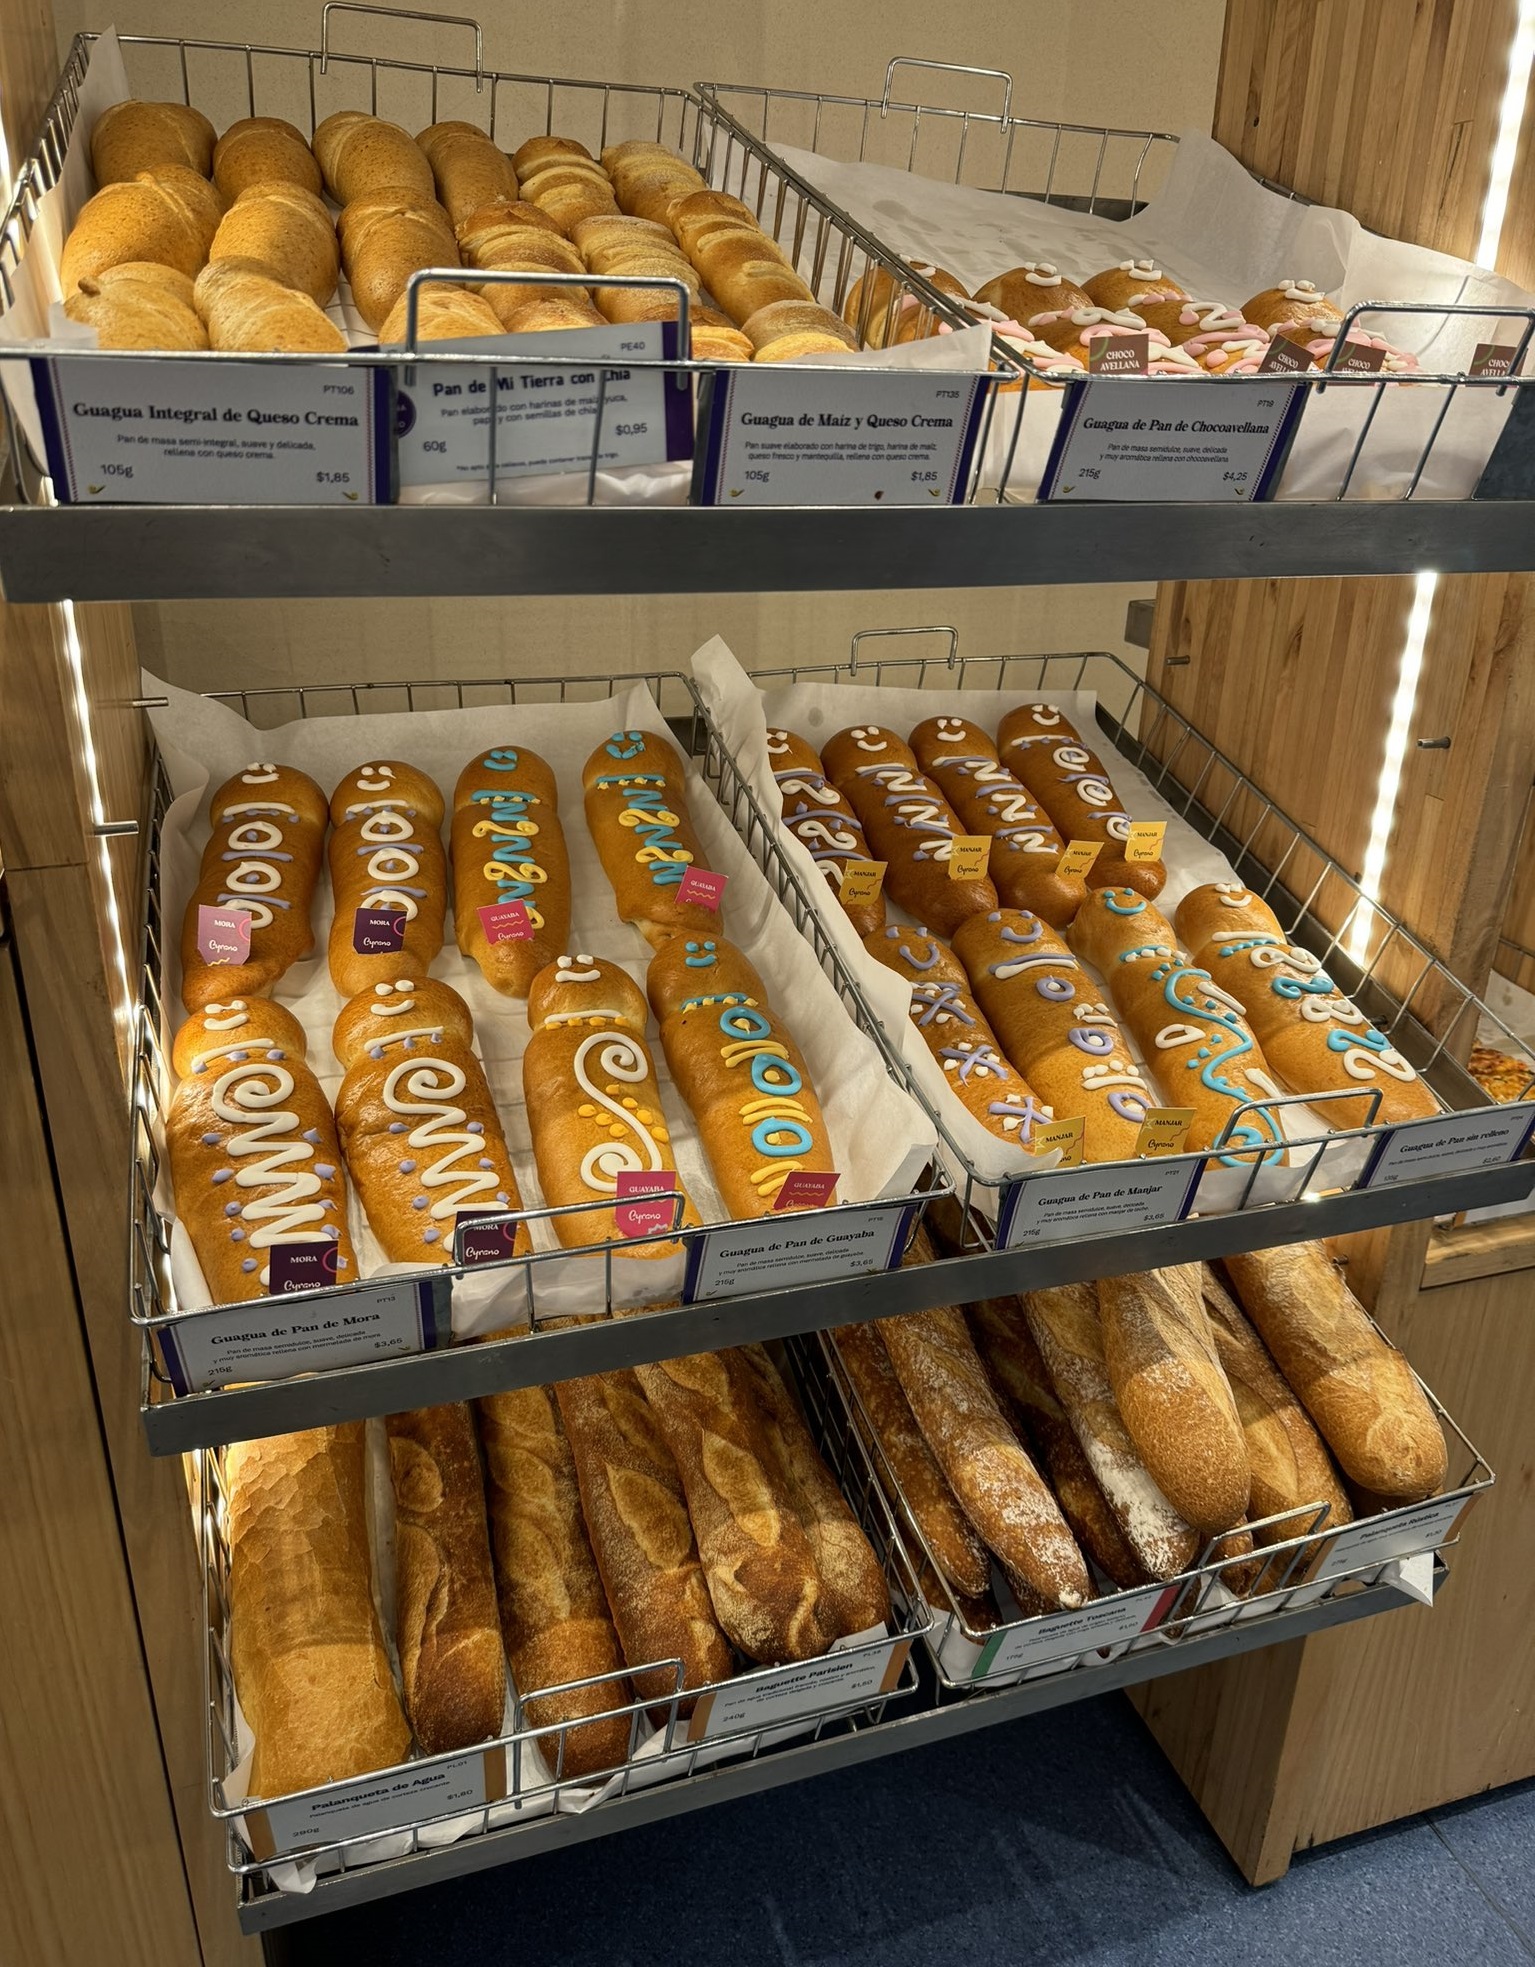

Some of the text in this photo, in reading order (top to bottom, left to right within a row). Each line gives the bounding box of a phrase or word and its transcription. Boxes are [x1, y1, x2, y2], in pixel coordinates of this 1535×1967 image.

[620, 342, 645, 351] PE40
[1106, 349, 1135, 360] CHOCO
[1100, 360, 1140, 371] AVELLANA
[1278, 353, 1299, 369] CHOCO
[1348, 358, 1370, 370] CHOCO
[1488, 359, 1510, 368] CHOC
[323, 385, 354, 395] PT106
[433, 383, 462, 396] Pan
[468, 380, 487, 394] de
[520, 373, 564, 389] Tierra
[570, 373, 595, 385] con
[935, 390, 960, 399] PT135
[441, 398, 577, 417] Pan con harinas de
[73, 402, 358, 426] Guagua Integral de Queso Crema
[498, 407, 577, 425] y con semillas de
[741, 412, 794, 429] Guagua
[799, 413, 815, 426] de
[854, 418, 863, 430] y
[867, 414, 907, 428] Queso
[911, 414, 953, 428] Crema
[1083, 417, 1270, 434] Guagua de Pan de Chocoavellana
[615, 423, 648, 436] $0,95
[117, 434, 275, 451] Pan de masa suave y
[423, 441, 448, 454] 60g
[745, 441, 760, 449] Pan
[761, 442, 782, 450] suave
[783, 442, 820, 450] elaborado
[835, 442, 857, 450] harina
[858, 443, 867, 451] de
[887, 442, 908, 451] harina
[910, 443, 918, 451] de
[216, 450, 243, 460] queso
[748, 453, 770, 461] queso
[772, 452, 795, 460] fresco
[796, 454, 800, 462] y
[846, 453, 870, 461] rellena
[886, 454, 907, 462] queso
[1104, 454, 1119, 462] muy
[100, 464, 134, 479] 105g
[745, 470, 770, 482] 105g
[911, 470, 938, 481] $1,85
[1078, 468, 1101, 480] 215g
[1223, 472, 1248, 481] $4,25
[490, 911, 520, 922] GUAYABA
[214, 919, 236, 929] MORA
[369, 919, 390, 927] MORA
[208, 940, 238, 954] Cyrano
[363, 937, 392, 949] Cyrano
[1045, 1132, 1074, 1143] MANJAR
[1400, 1143, 1434, 1153] Guagua
[1435, 1139, 1447, 1147] de
[1466, 1133, 1479, 1142] sin
[1480, 1129, 1510, 1139] relleno
[1148, 1139, 1175, 1151] Cyrano
[793, 1182, 825, 1190] GUAYABA
[1038, 1186, 1163, 1206] Guagua de Pan de Manjar
[628, 1209, 662, 1222] Cyrano
[473, 1223, 499, 1231] MORA
[720, 1231, 875, 1258] Guagua de Pan de Guayaba
[465, 1247, 500, 1260] Cyrano
[290, 1256, 318, 1264] MORA
[283, 1280, 321, 1292] Cyrano
[211, 1314, 381, 1345] Guagua de Pan de Mora
[208, 1366, 233, 1376] 215g
[756, 1675, 807, 1693] Baguette
[311, 1774, 446, 1811] Palanqueta de Agua
